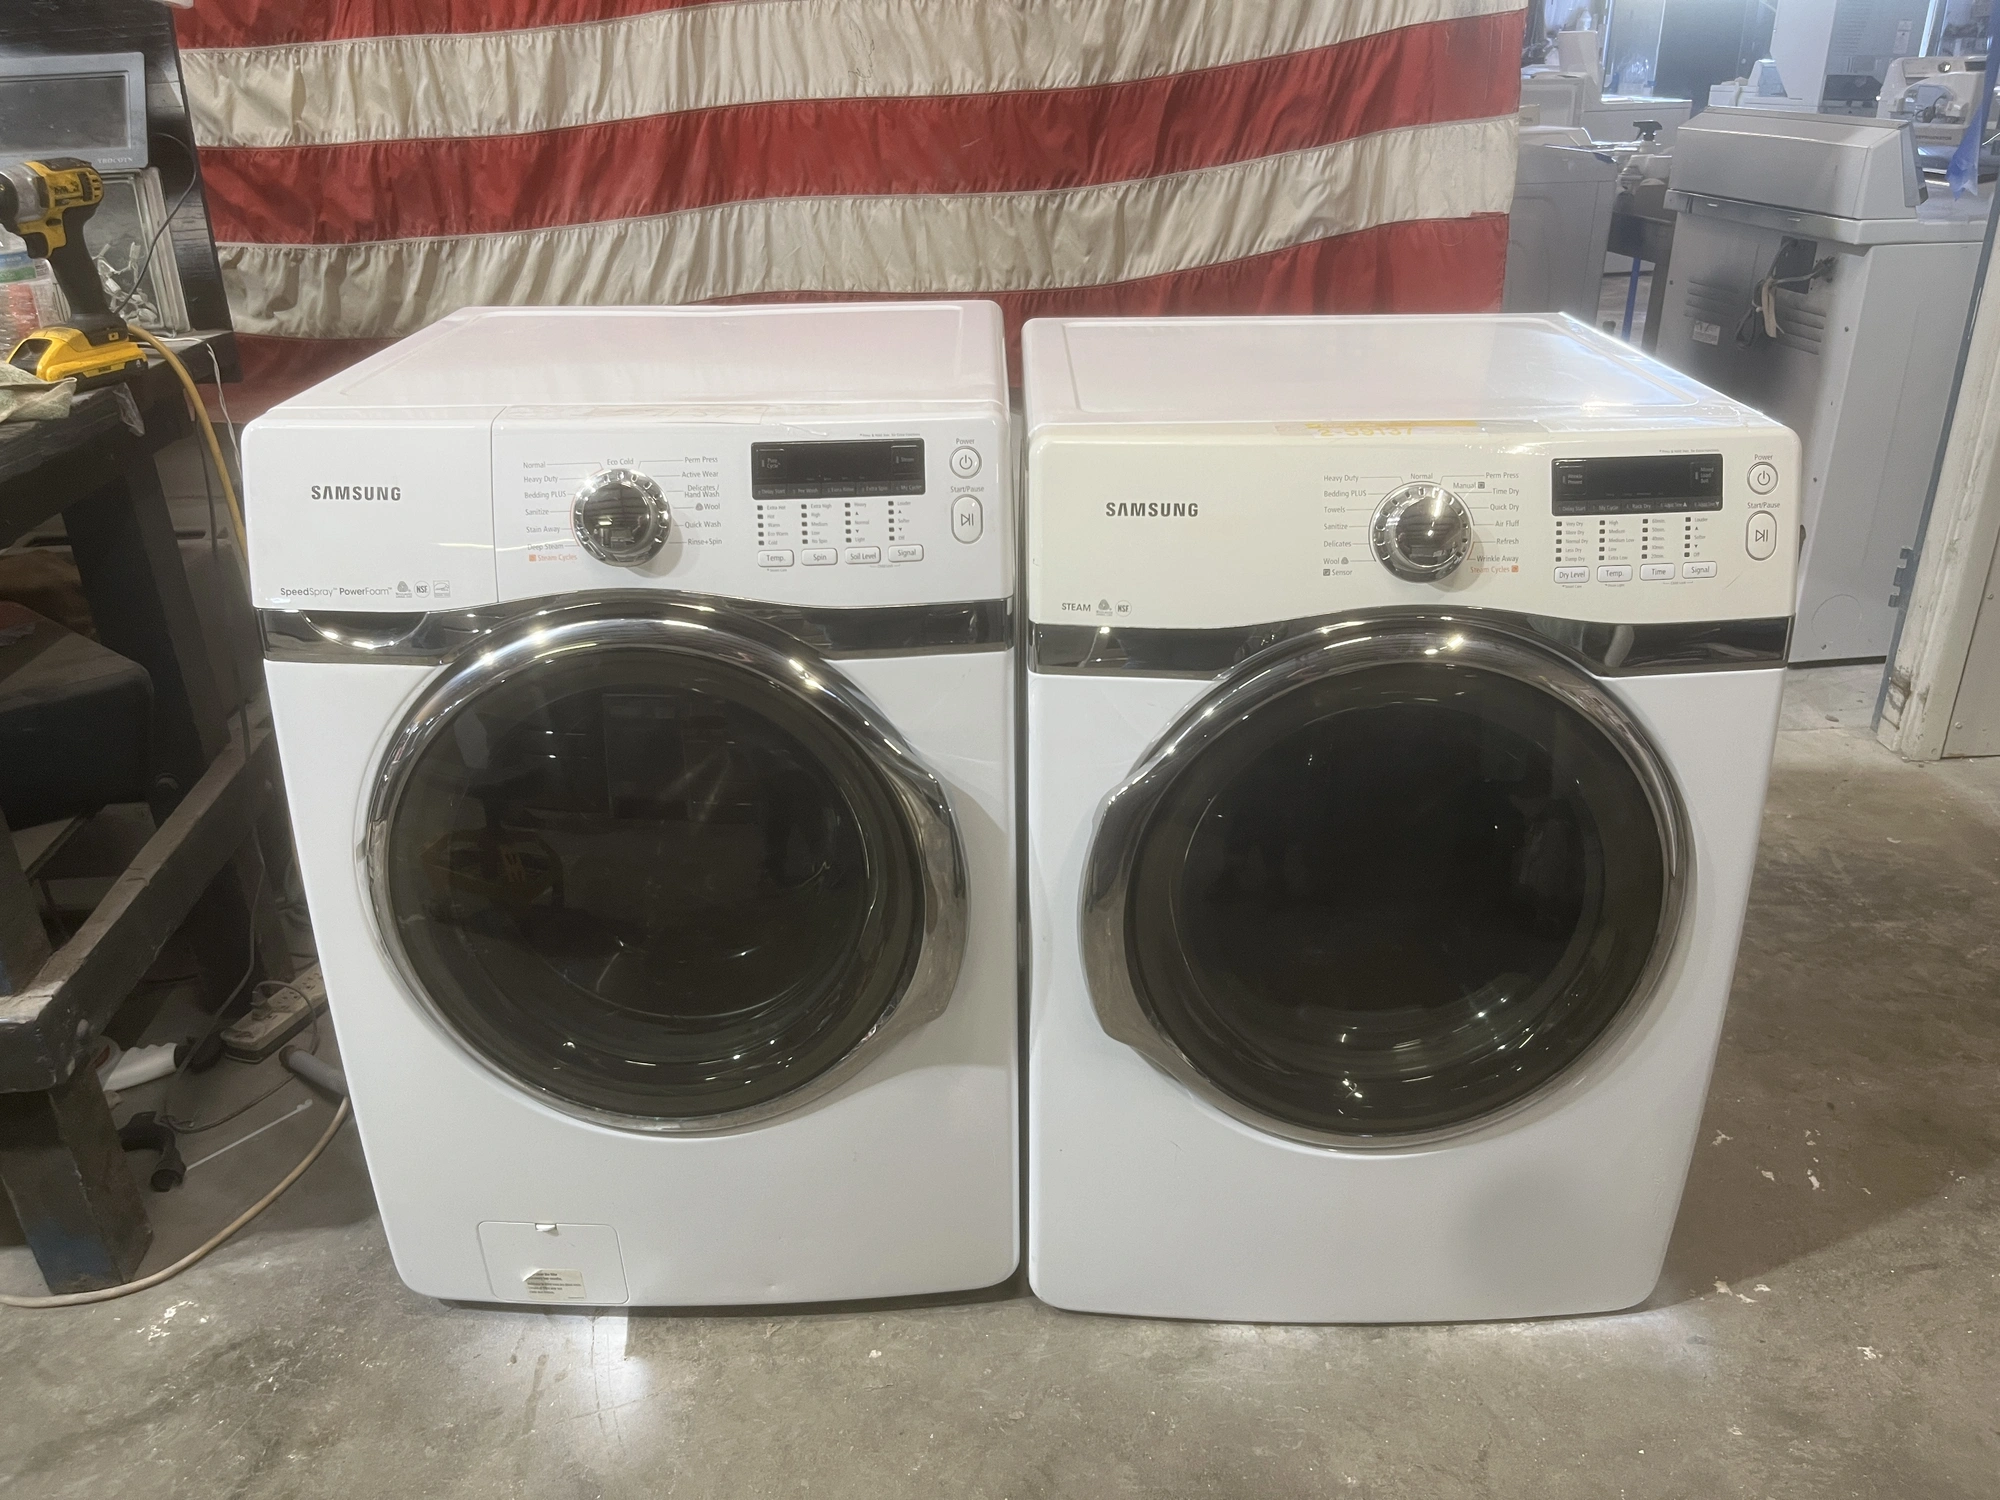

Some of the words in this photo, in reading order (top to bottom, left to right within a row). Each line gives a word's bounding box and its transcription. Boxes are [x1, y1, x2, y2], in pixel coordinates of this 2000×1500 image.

[955, 437, 975, 445] Power
[523, 461, 546, 469] Normal
[1323, 475, 1343, 483] Heavy
[1344, 474, 1359, 483] Duty
[1410, 472, 1433, 480] Normal
[1503, 471, 1519, 479] Press
[523, 476, 542, 484] Heavy
[543, 475, 559, 483] Duty
[311, 485, 401, 501] SAMSUNG
[950, 485, 985, 493] Start/Pause
[1492, 487, 1507, 495] Time
[1509, 488, 1520, 496] Dry
[524, 491, 549, 500] Bedding
[551, 490, 567, 498] PLUS
[702, 490, 720, 498] Wash
[1323, 490, 1350, 498] Bedding
[1489, 503, 1508, 511] Quick
[1508, 503, 1520, 511] Dry
[1747, 501, 1781, 509] Start/Pause
[525, 508, 549, 516] Sanitize
[1105, 502, 1199, 517] SAMSUNG
[684, 521, 702, 529] Quick
[703, 520, 722, 528] Wash
[1505, 519, 1520, 527] Fluff
[687, 538, 723, 546] Rinse+Spin
[1496, 537, 1520, 545] Refresh
[527, 543, 543, 551] Deep
[813, 553, 828, 562] Spin
[862, 552, 877, 560] Level
[897, 549, 917, 558] Signal
[558, 554, 577, 562] Cycles
[766, 554, 786, 563] Temp.
[1501, 555, 1519, 563] Away
[1331, 568, 1353, 576] Sensor
[1491, 565, 1510, 574] Cycles
[1651, 568, 1666, 576] Time
[1691, 566, 1710, 574] Signal
[1558, 571, 1570, 580] Dry
[1605, 570, 1624, 578] Temp.
[416, 585, 428, 593] NSF
[1061, 602, 1092, 612] STEAM
[1117, 604, 1129, 613] NSF
